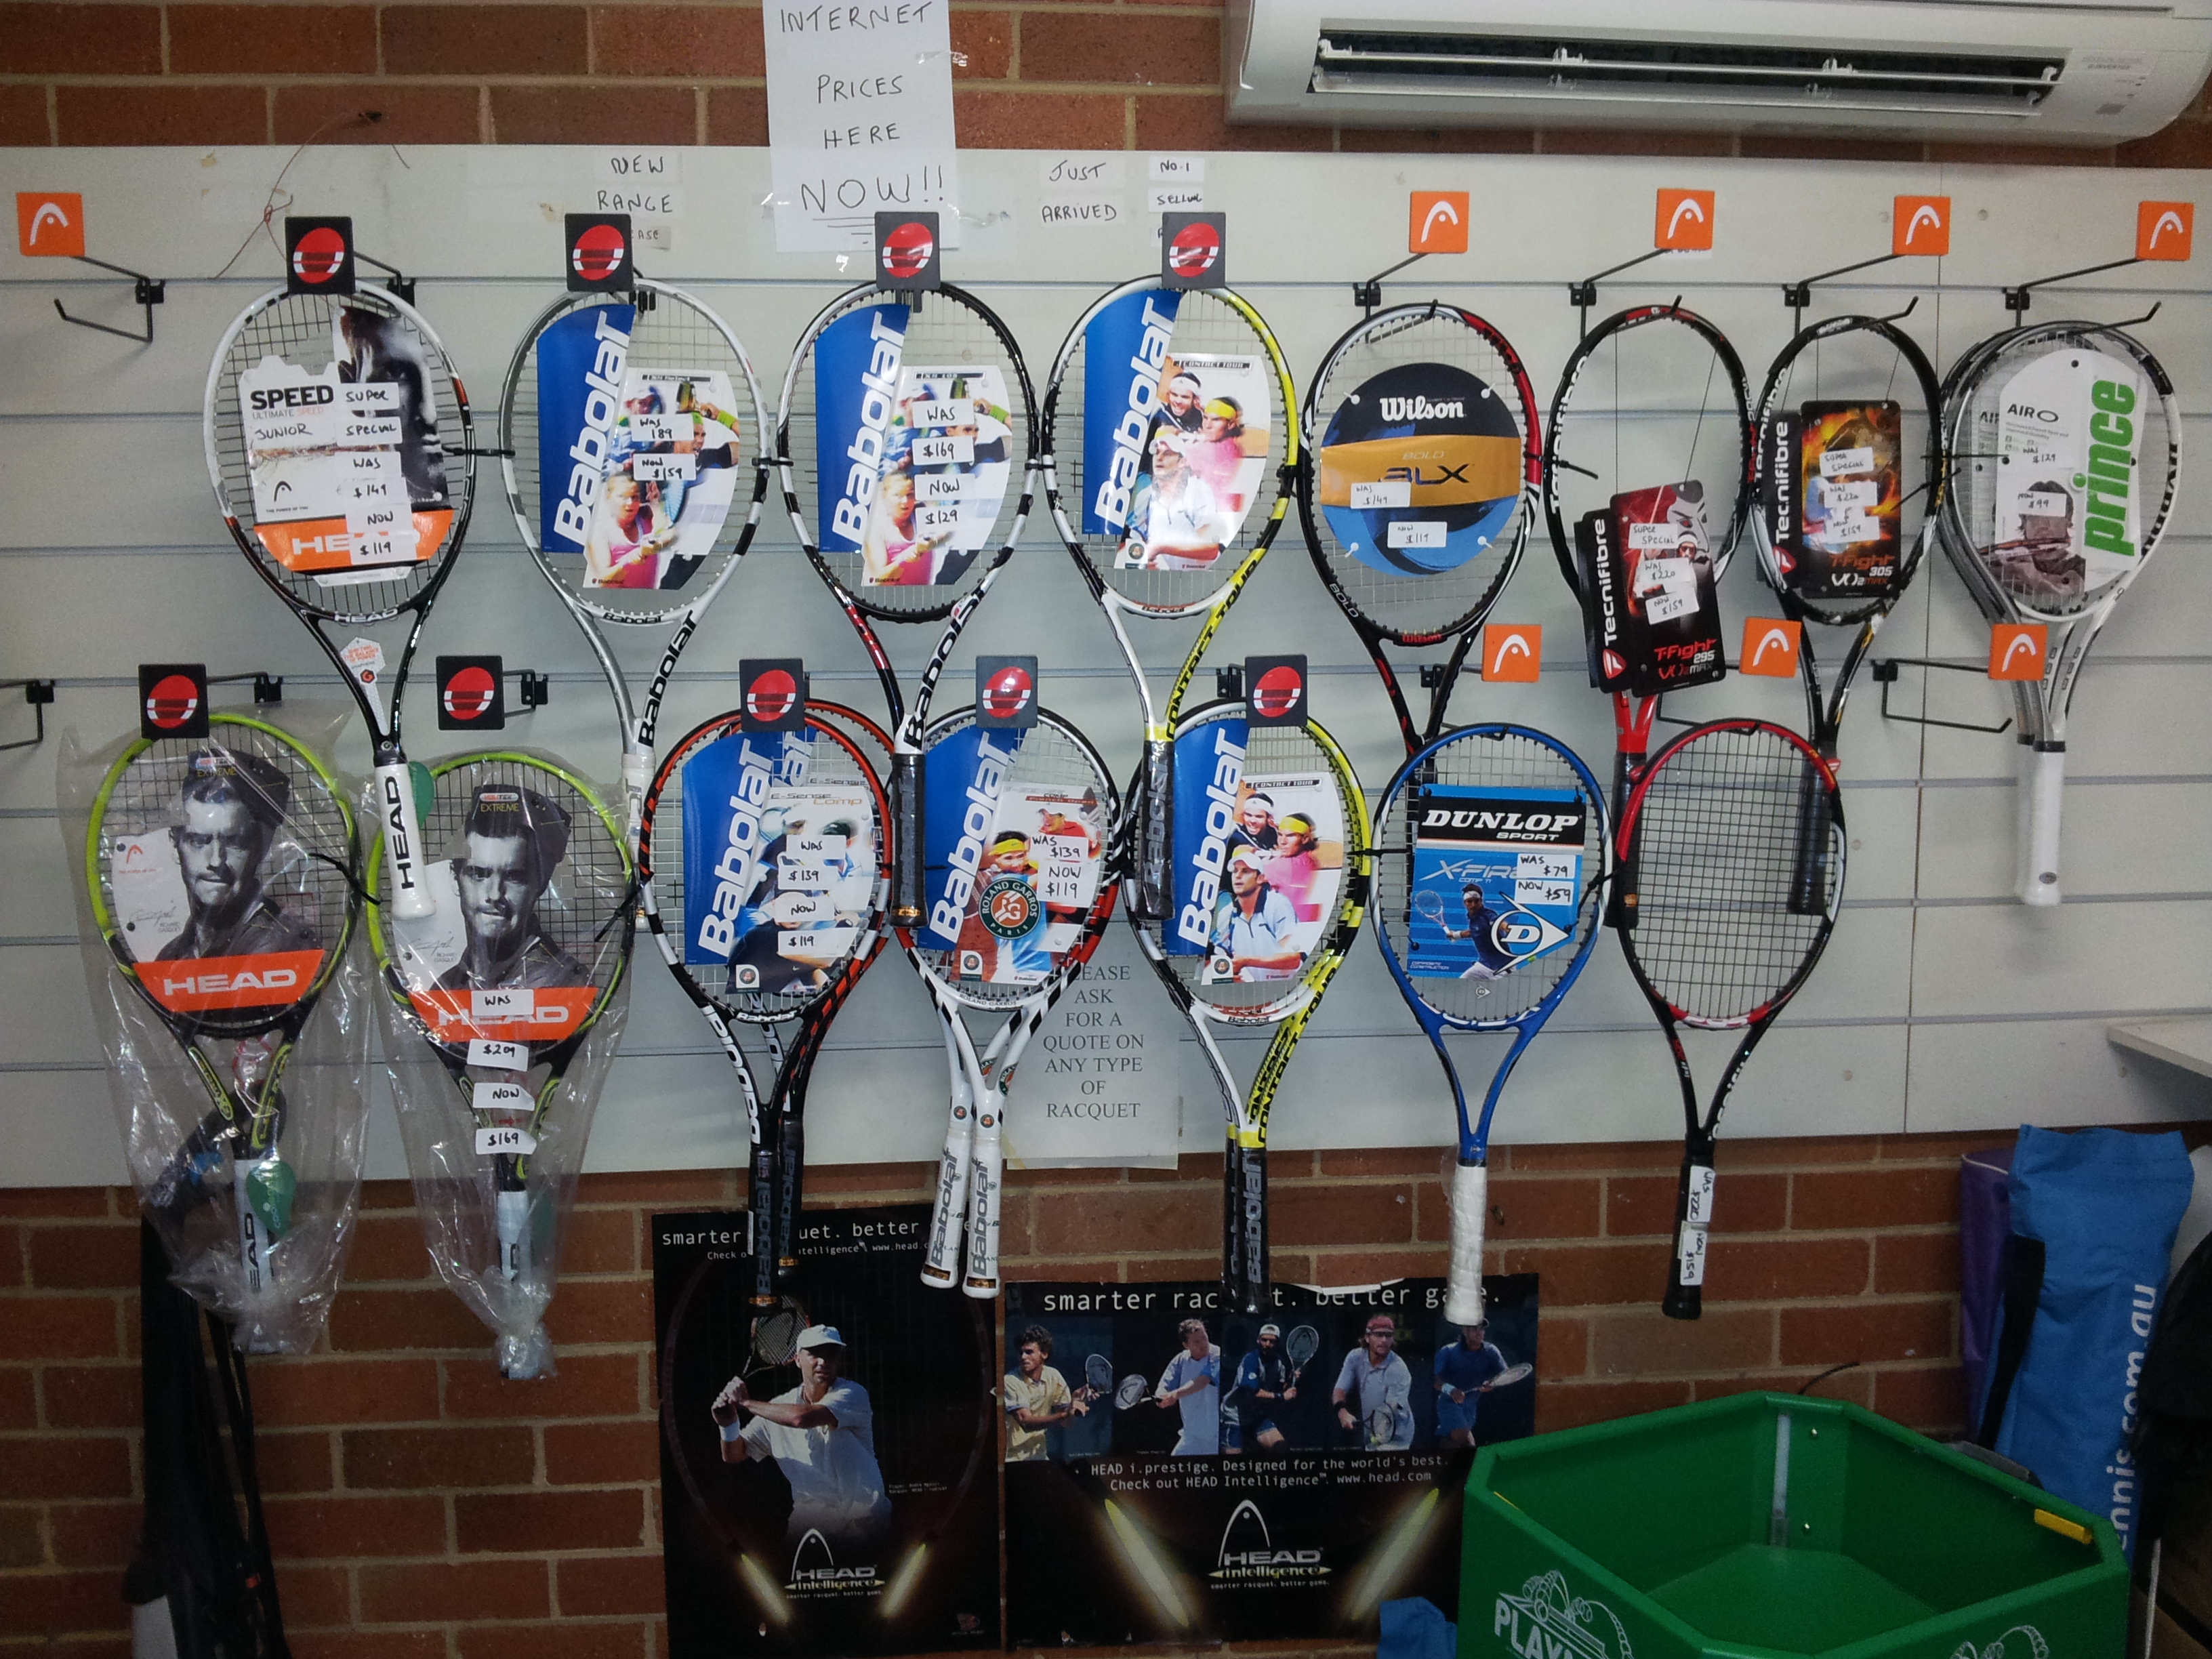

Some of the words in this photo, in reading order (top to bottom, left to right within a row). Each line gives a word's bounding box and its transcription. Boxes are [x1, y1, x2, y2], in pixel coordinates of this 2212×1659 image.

[781, 1, 932, 33] INTERNET
[818, 75, 903, 104] PRICES
[825, 123, 901, 149] HERE
[611, 155, 663, 174] NEW
[1049, 160, 1106, 182] JUST
[801, 165, 943, 213] NOW!!
[597, 190, 673, 213] RANGE
[1042, 204, 1117, 222] ARRIVED
[251, 384, 334, 410] SPEED
[252, 409, 293, 419] ULTIMATE
[927, 406, 955, 421] WAS
[1380, 395, 1464, 421] Wilson
[255, 423, 312, 440] JUNIOR
[652, 428, 672, 439] 189
[923, 442, 954, 459] $169
[1403, 451, 1444, 460] BOLD
[353, 457, 381, 468] WAS
[2072, 380, 2135, 556] prince
[930, 478, 960, 495] NOW
[1775, 421, 1789, 544] Tecnifibre
[354, 483, 386, 499] $149
[367, 511, 393, 525] NOW
[925, 510, 958, 525] $129
[360, 541, 391, 556] $119
[1869, 567, 1893, 577] 305
[1595, 518, 1618, 646] Tecnifibre
[1330, 583, 1359, 618] BOLD
[335, 609, 397, 623] HEAD
[1694, 650, 1715, 663] 295
[480, 803, 519, 812] EXTREME
[1422, 809, 1580, 832] DUNLOP
[384, 776, 415, 890] HEAD
[1496, 832, 1559, 841] SPORT
[801, 840, 823, 851] WAS
[1032, 836, 1057, 846] WAS
[1050, 847, 1080, 858] $139
[1520, 856, 1544, 865] WAS
[787, 869, 819, 882] $139
[1048, 866, 1081, 878] NOW
[1543, 865, 1568, 877] $79
[1046, 882, 1078, 899] $119
[1518, 881, 1544, 890] NOW
[982, 882, 1009, 914] ROLAND
[1012, 882, 1038, 918] GARROS
[1544, 888, 1571, 903] $59
[790, 901, 816, 916] NOW
[990, 922, 1028, 936] PARIS
[787, 935, 815, 947] $119
[1073, 966, 1130, 981] EASE
[163, 969, 296, 996] HEAD
[485, 995, 512, 1006] WAS
[960, 994, 987, 1005] ROLAND
[1074, 989, 1113, 1004] ASK
[438, 1006, 569, 1026] HEAD
[1065, 1012, 1103, 1027] FOR
[1109, 1012, 1122, 1026] A
[1043, 1035, 1110, 1052] QUOTE
[1116, 1034, 1144, 1048] ON
[1044, 1058, 1087, 1073] ANY
[1093, 1057, 1143, 1072] TYPE
[492, 1087, 520, 1100] NOW
[1081, 1080, 1106, 1095] OF
[1046, 1103, 1141, 1120] RACQUET
[488, 1132, 519, 1146] $169
[662, 1231, 741, 1246] smarter
[853, 1222, 920, 1237] better
[708, 1250, 736, 1259] Check
[1044, 1290, 1156, 1311] smarter
[1315, 1288, 1410, 1306] better
[1091, 1463, 1123, 1475] HEAD
[1130, 1461, 1214, 1476] i.prestige.
[1223, 1460, 1286, 1473] Designed
[1294, 1459, 1315, 1471] for
[1323, 1459, 1345, 1469] the
[1351, 1456, 1405, 1469] world's
[1412, 1456, 1448, 1467] best.
[1110, 1479, 1149, 1491] Check
[1156, 1478, 1179, 1488] out
[1186, 1477, 1218, 1488] HEAD
[1337, 1472, 1431, 1484] www.head.com
[1224, 1550, 1321, 1566] HEAD
[796, 1566, 876, 1580] HEAD
[1223, 1565, 1317, 1578] intelligence
[797, 1580, 874, 1591] intelligence
